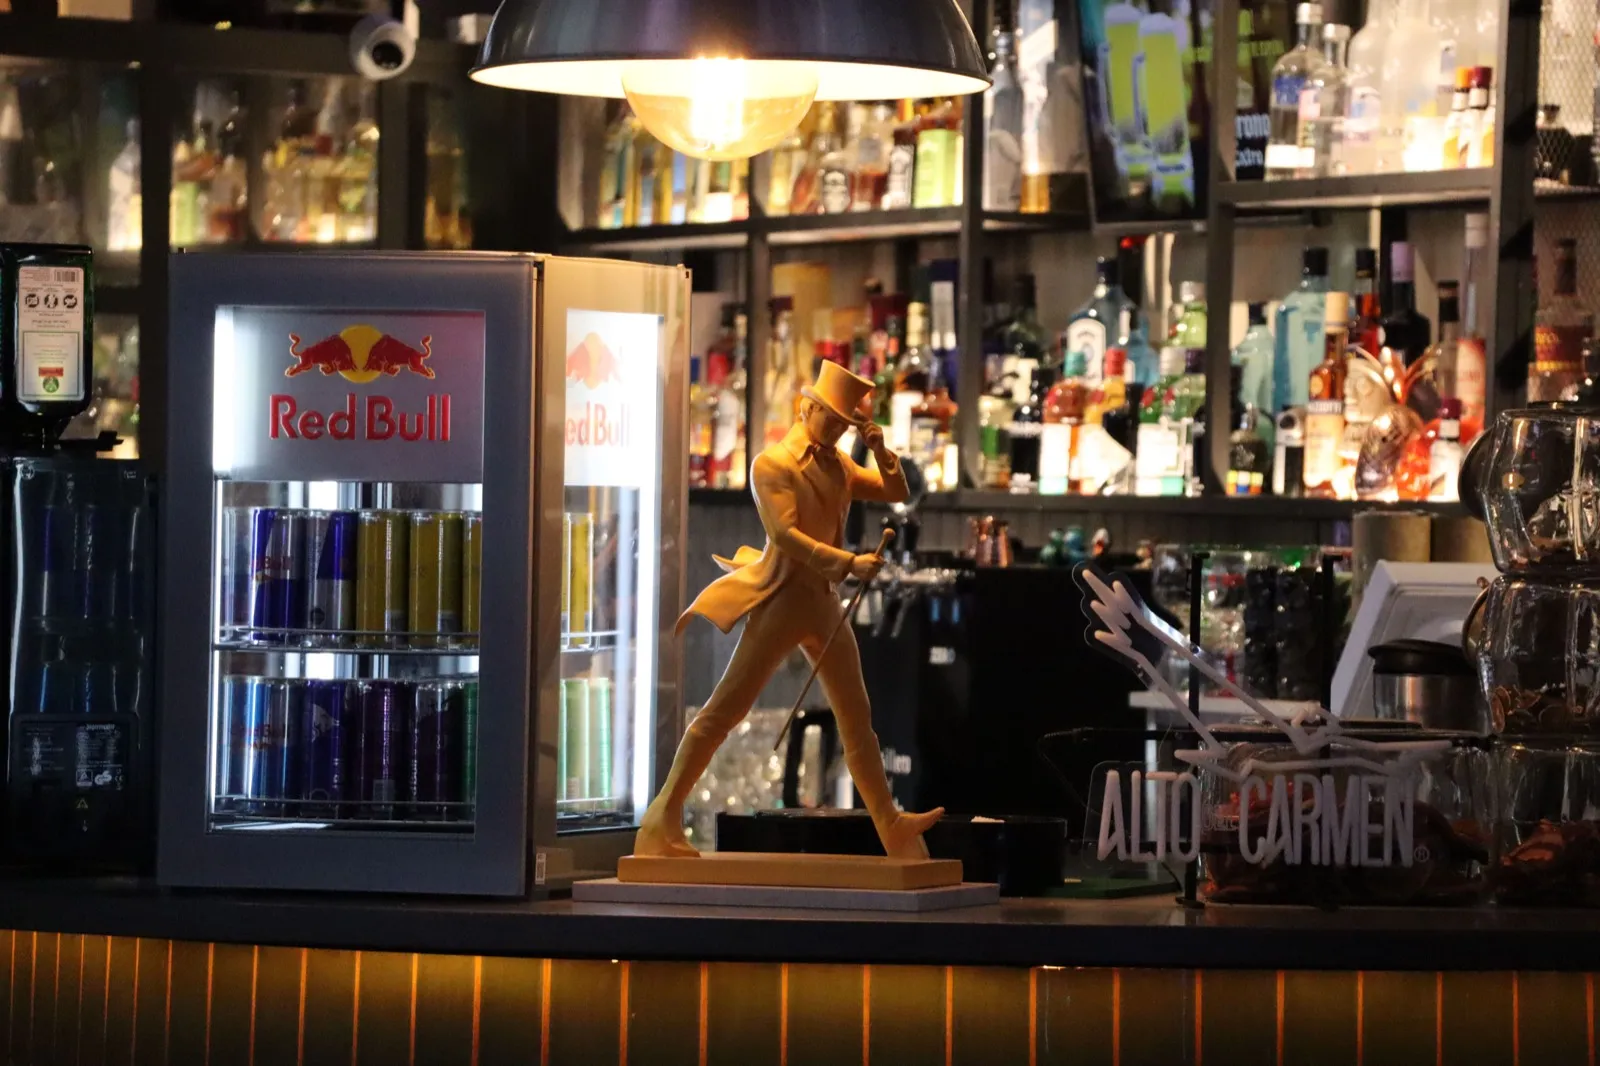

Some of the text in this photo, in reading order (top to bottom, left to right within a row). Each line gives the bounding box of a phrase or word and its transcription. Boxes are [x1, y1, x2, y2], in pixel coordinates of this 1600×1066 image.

[269, 392, 451, 441] Red Bull
[565, 400, 630, 448] ed Bull
[1098, 770, 1200, 863] ALTO
[1239, 773, 1414, 868] CARMEN
